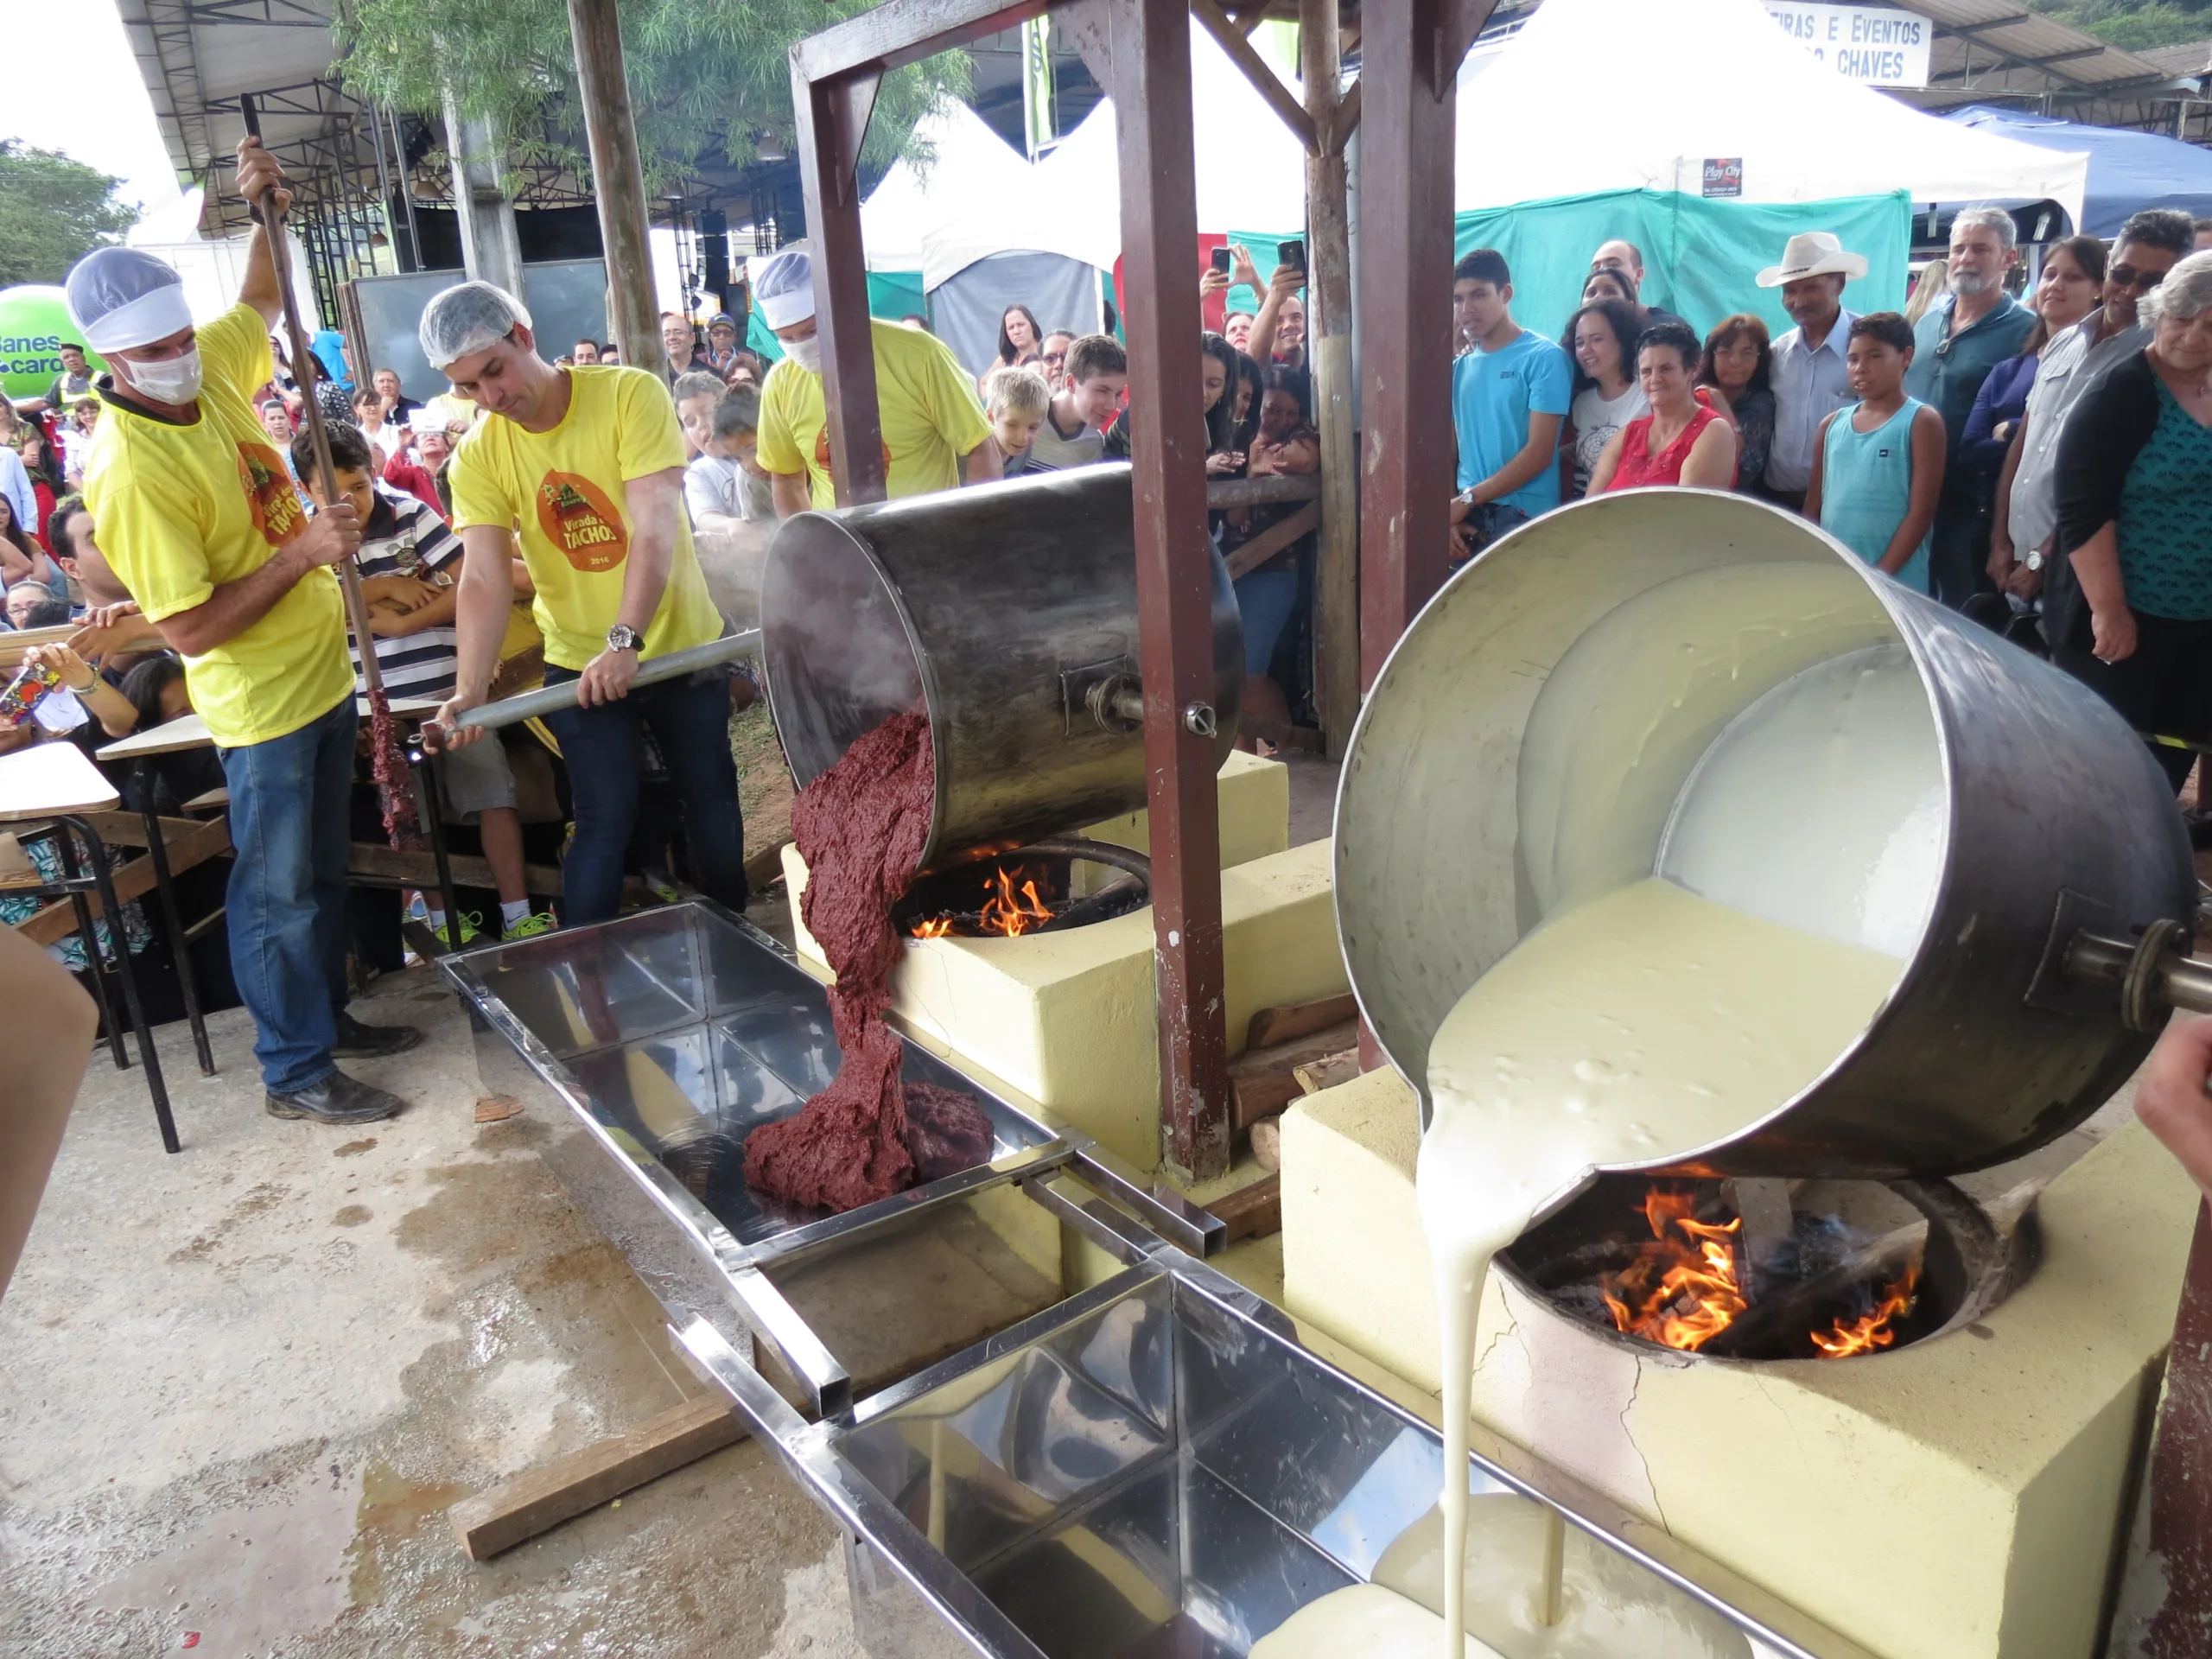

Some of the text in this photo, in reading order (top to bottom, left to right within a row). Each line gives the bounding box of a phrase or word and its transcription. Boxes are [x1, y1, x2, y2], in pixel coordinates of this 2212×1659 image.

[1770, 12, 1921, 46] IRAS E EVENTOS
[1837, 49, 1904, 79] CHAVES
[1705, 165, 1724, 180] Play
[0, 335, 61, 353] anes
[564, 514, 598, 531] Virada
[591, 556, 610, 565] 2016
